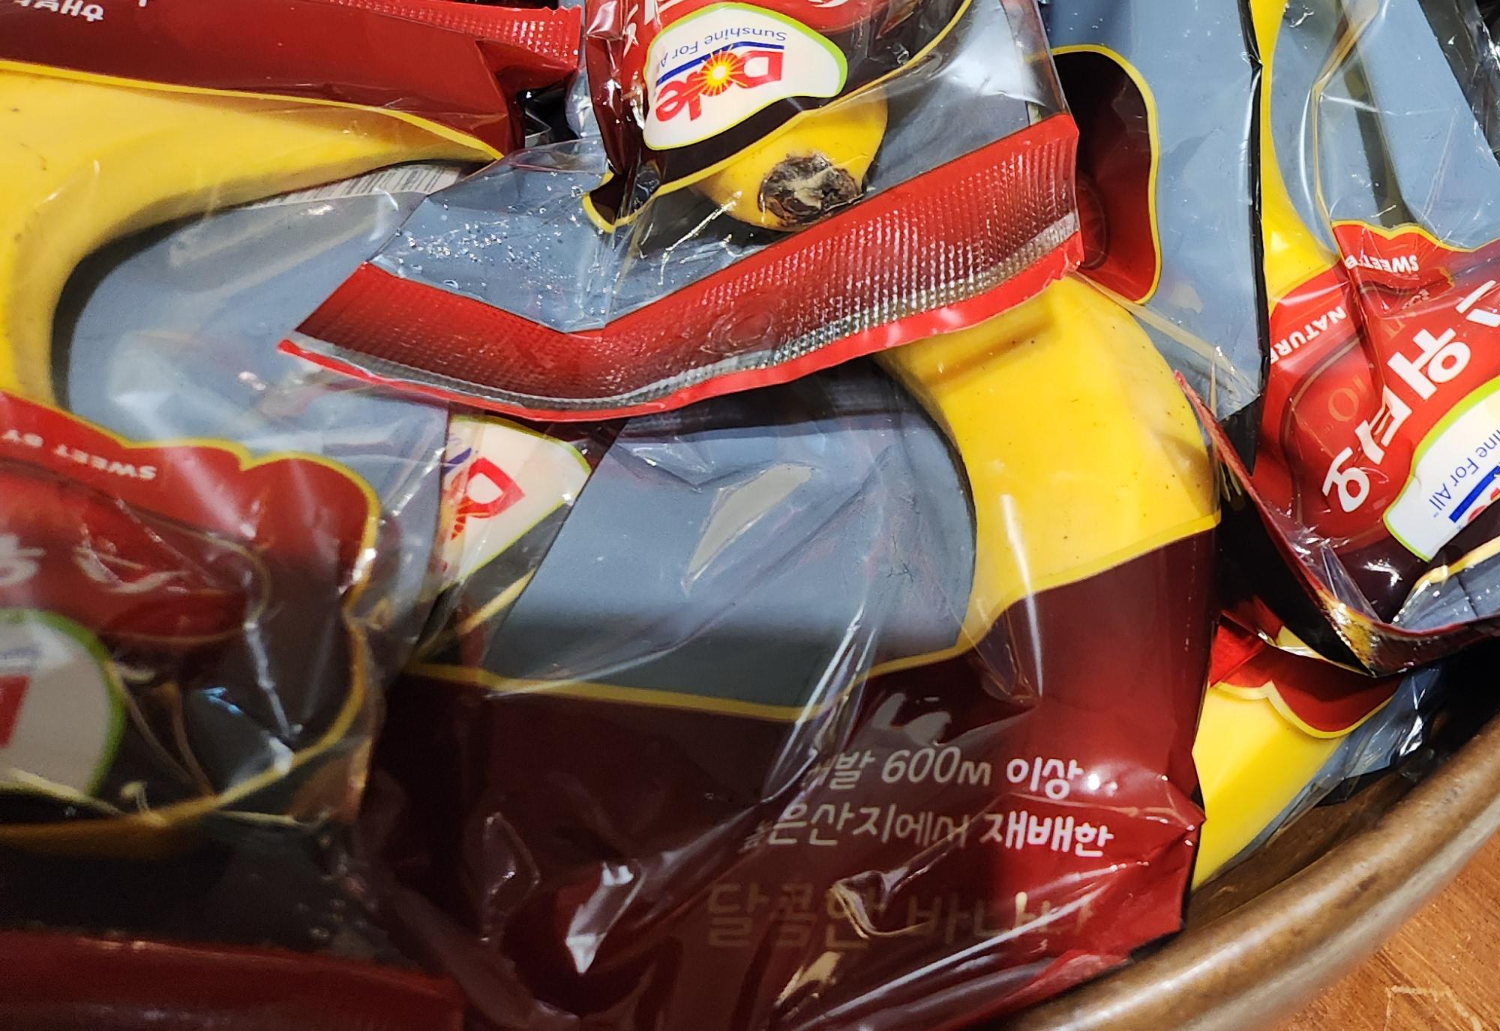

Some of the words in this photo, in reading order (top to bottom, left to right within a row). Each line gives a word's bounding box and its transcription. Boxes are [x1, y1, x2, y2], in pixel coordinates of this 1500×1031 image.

[672, 41, 699, 59] For
[704, 26, 788, 47] Sunshine
[656, 49, 785, 122] Dole
[54, 444, 157, 481] SWEET
[1450, 457, 1479, 487] For
[1428, 482, 1452, 511] All
[1005, 756, 1085, 801] 이상
[981, 810, 1115, 859] 재배한
